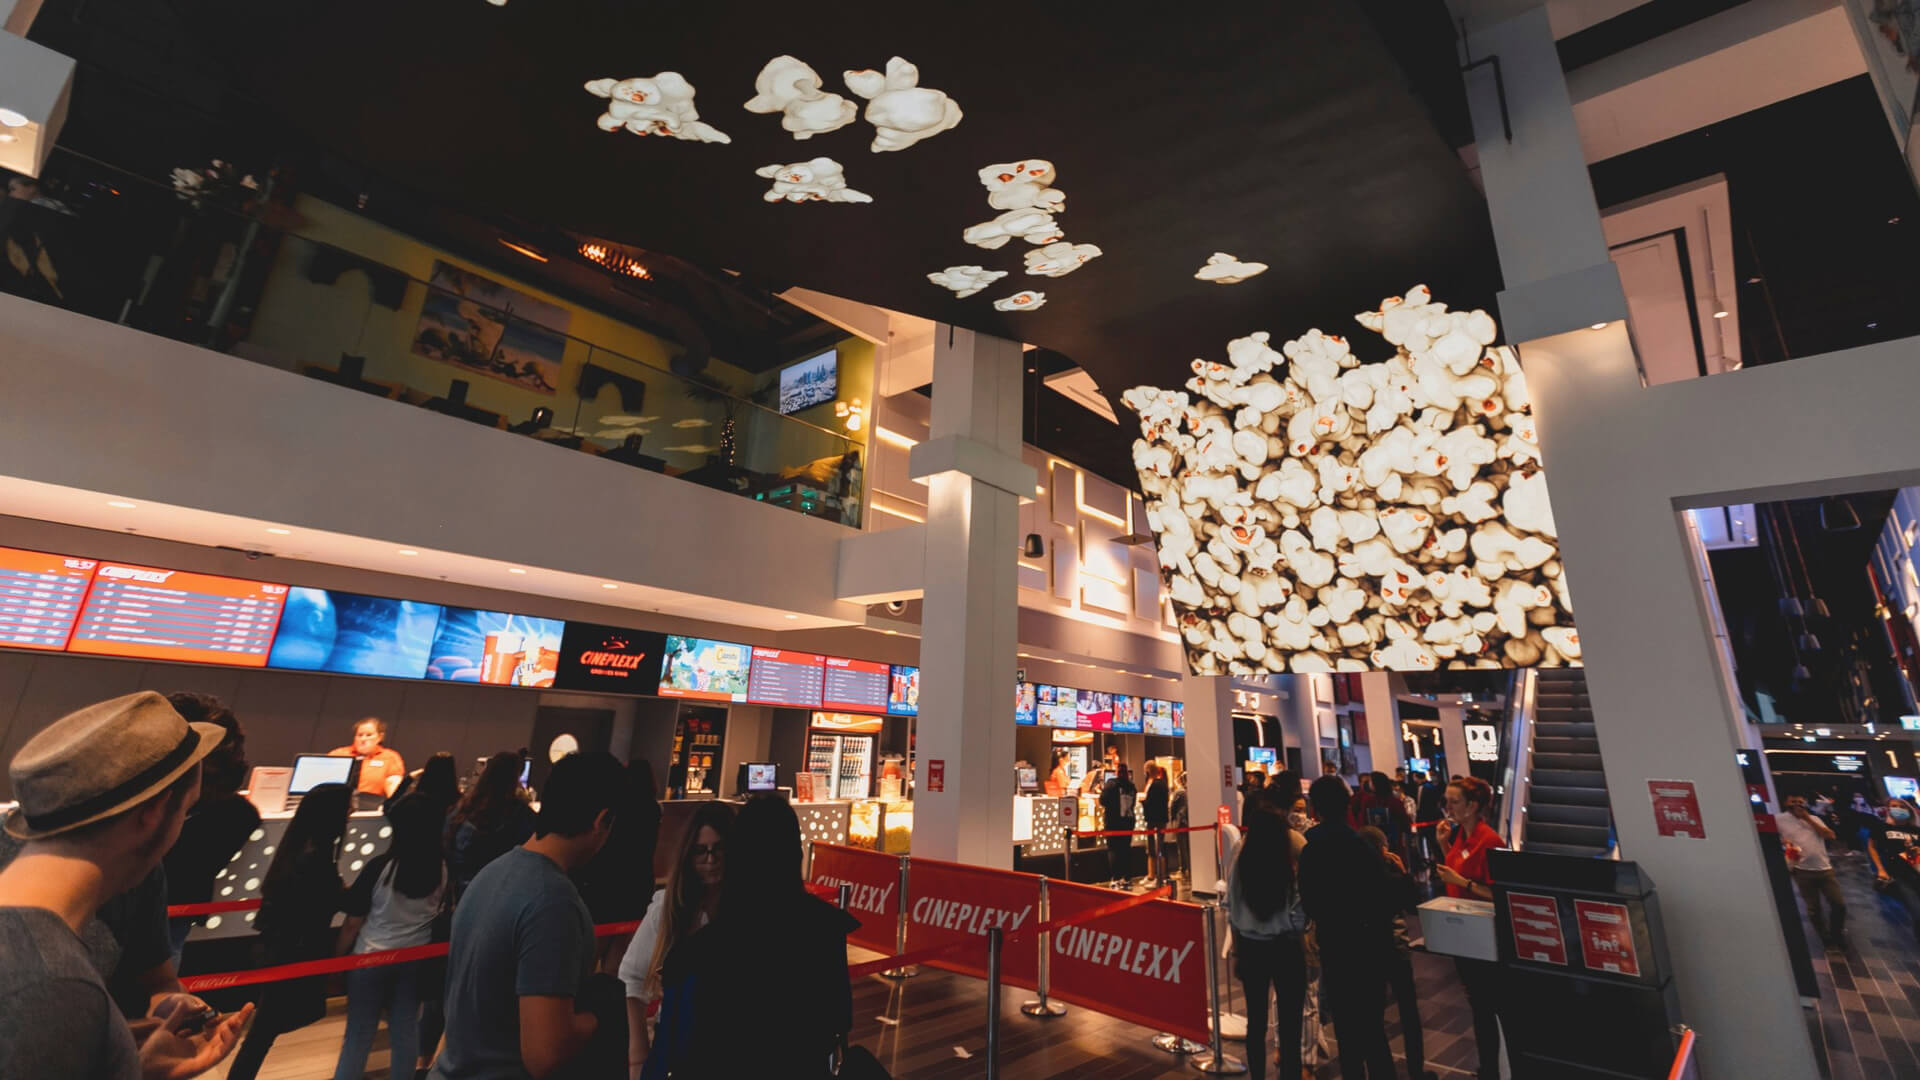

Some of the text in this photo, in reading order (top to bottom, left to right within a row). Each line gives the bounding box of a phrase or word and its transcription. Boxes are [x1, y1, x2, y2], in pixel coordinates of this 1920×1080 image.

[580, 650, 645, 669] CINEPLEXX
[912, 897, 1033, 936] CINEPLEXX
[1055, 924, 1195, 984] CINEPLEXX
[188, 975, 239, 990] CINEPLEXX
